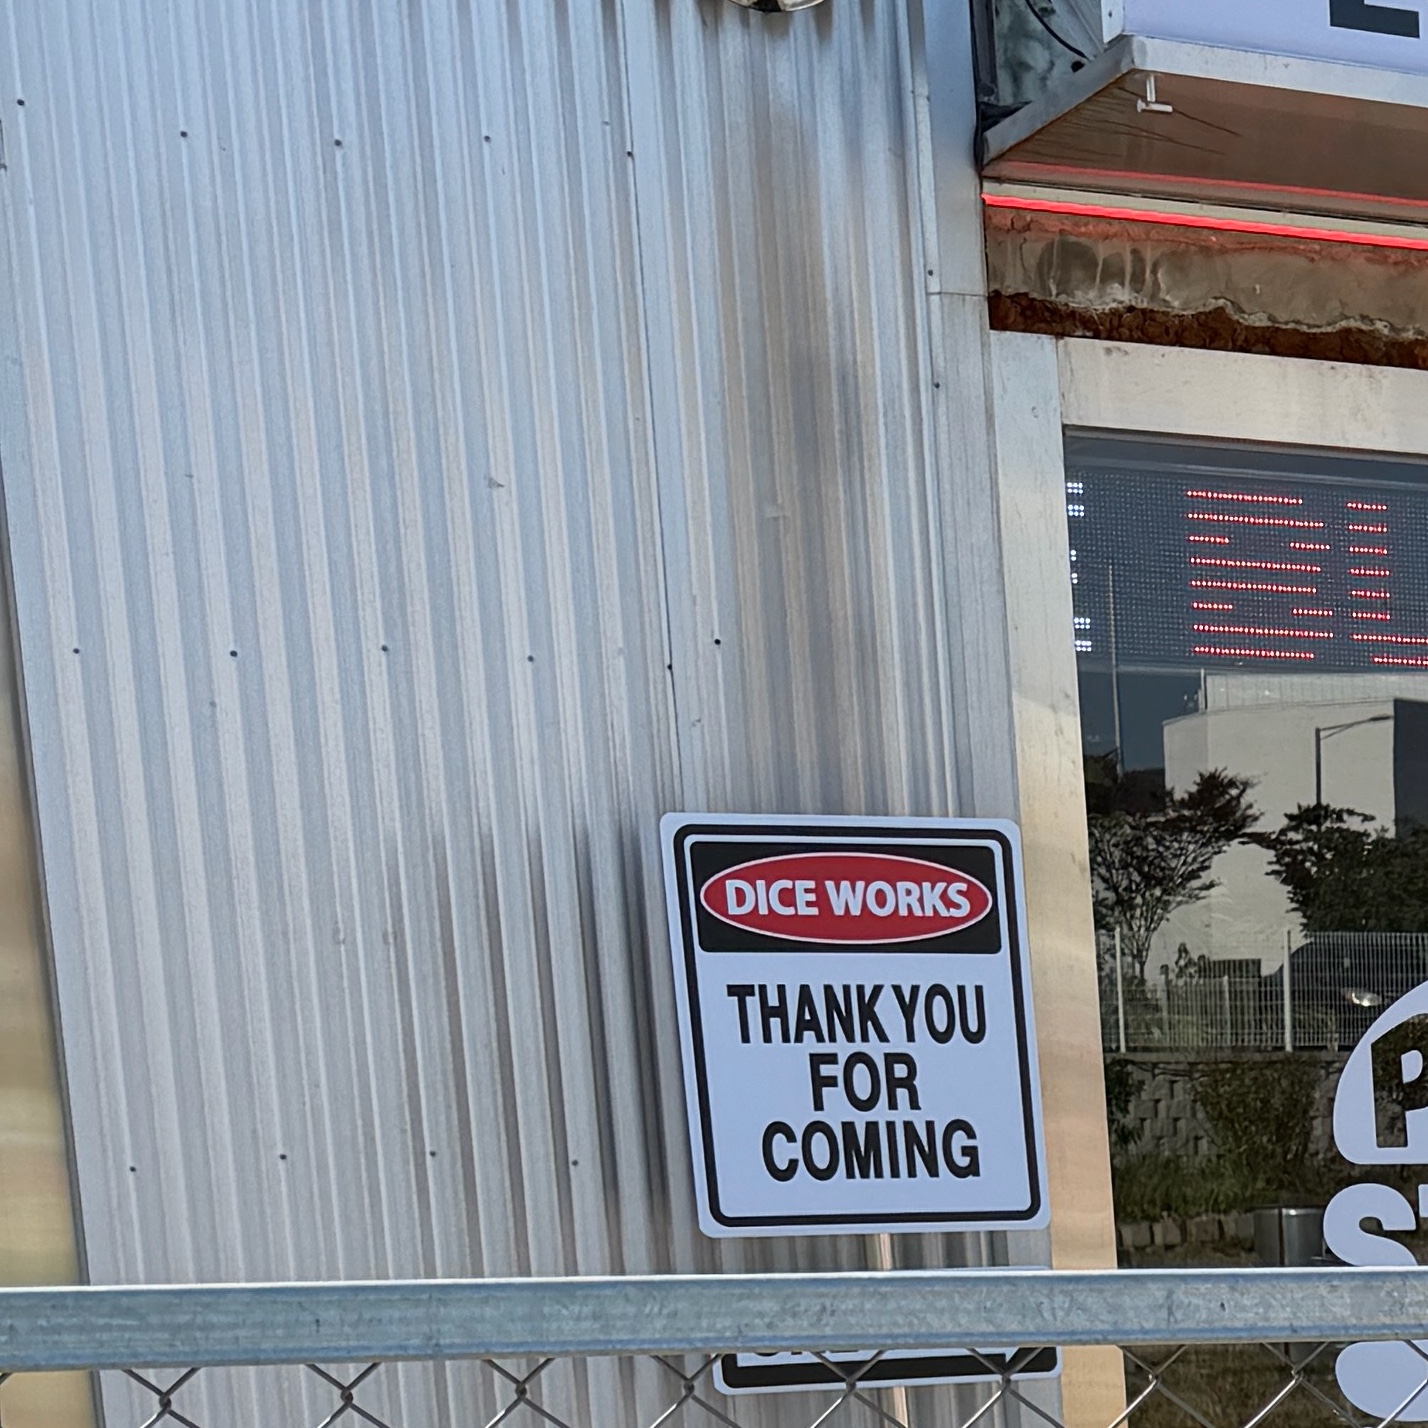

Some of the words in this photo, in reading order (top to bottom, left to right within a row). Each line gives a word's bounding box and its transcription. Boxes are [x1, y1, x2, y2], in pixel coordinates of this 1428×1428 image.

[726, 878, 819, 916] DICE
[824, 880, 971, 918] WORKS
[726, 983, 889, 1044] THANK
[891, 983, 986, 1044] YOU
[808, 1052, 921, 1112] FOR
[762, 1119, 980, 1182] COMING
